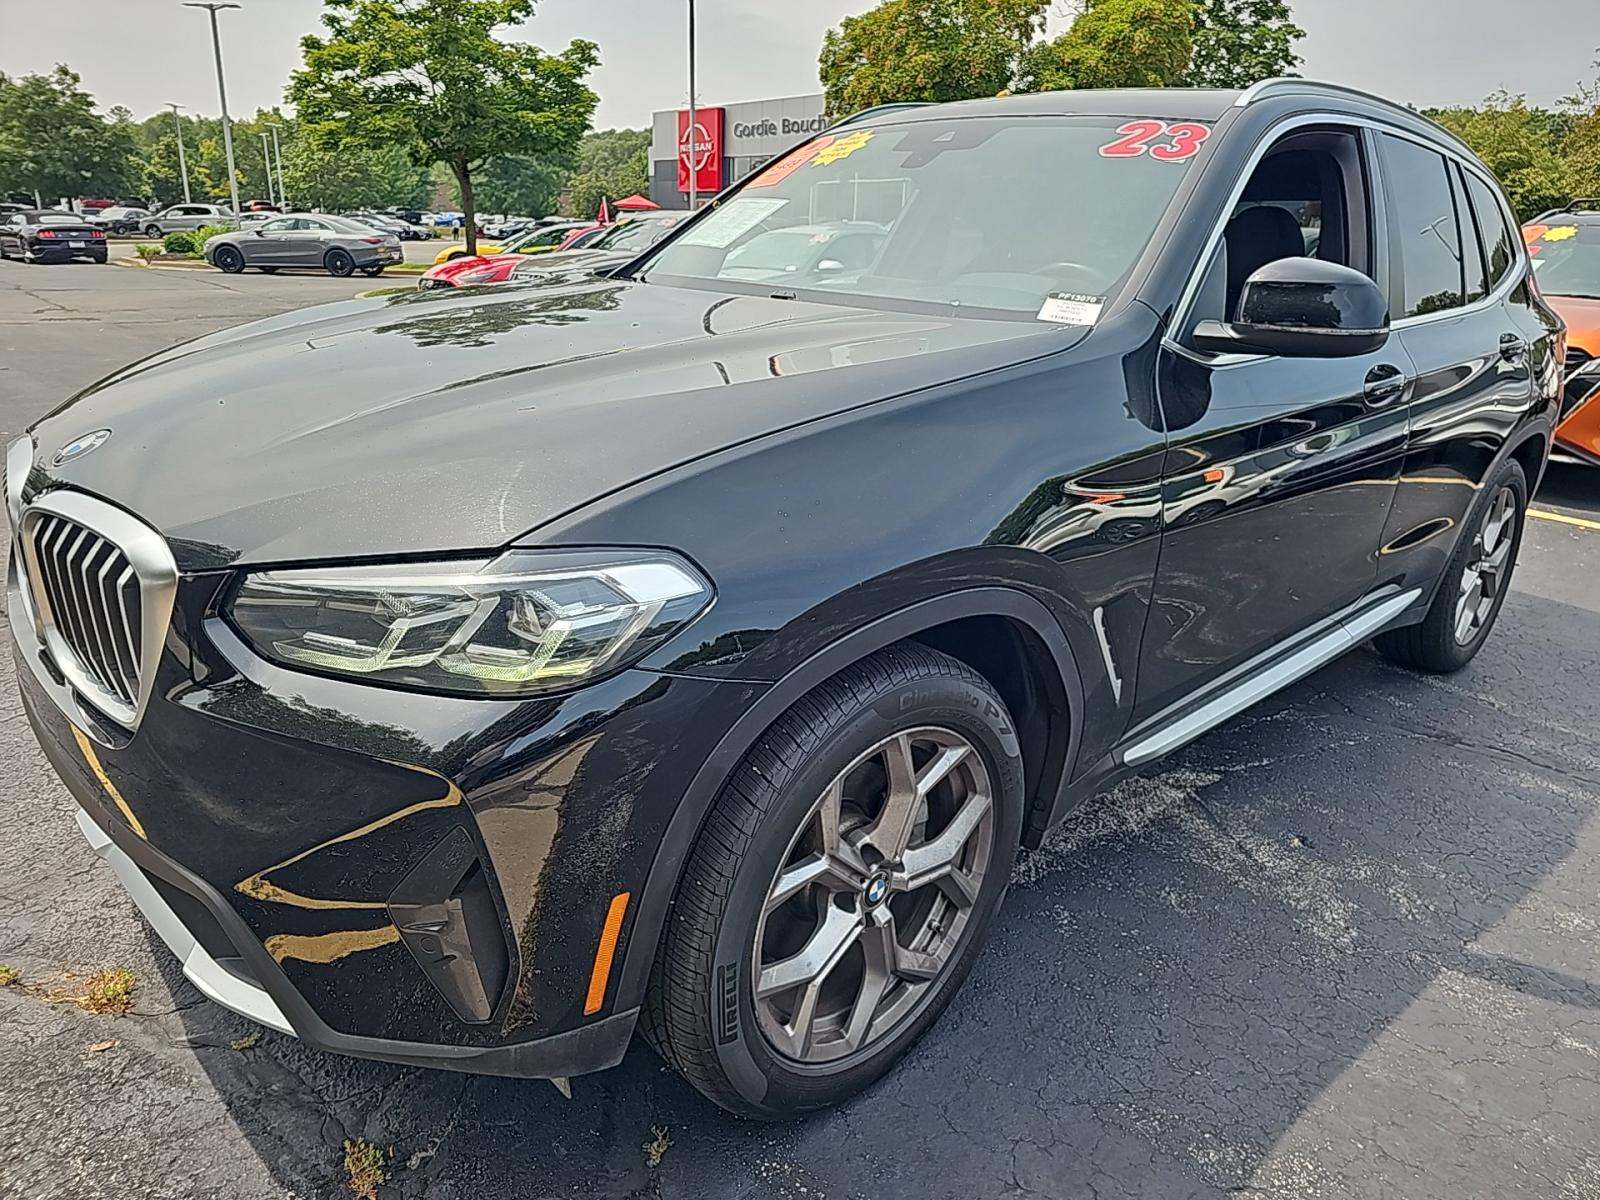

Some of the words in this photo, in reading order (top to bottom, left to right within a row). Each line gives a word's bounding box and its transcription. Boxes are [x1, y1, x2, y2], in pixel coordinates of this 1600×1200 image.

[734, 119, 777, 138] Gordie
[782, 114, 829, 135] Bouch
[1099, 119, 1211, 161] 23
[717, 962, 738, 1045] PIRELLI
